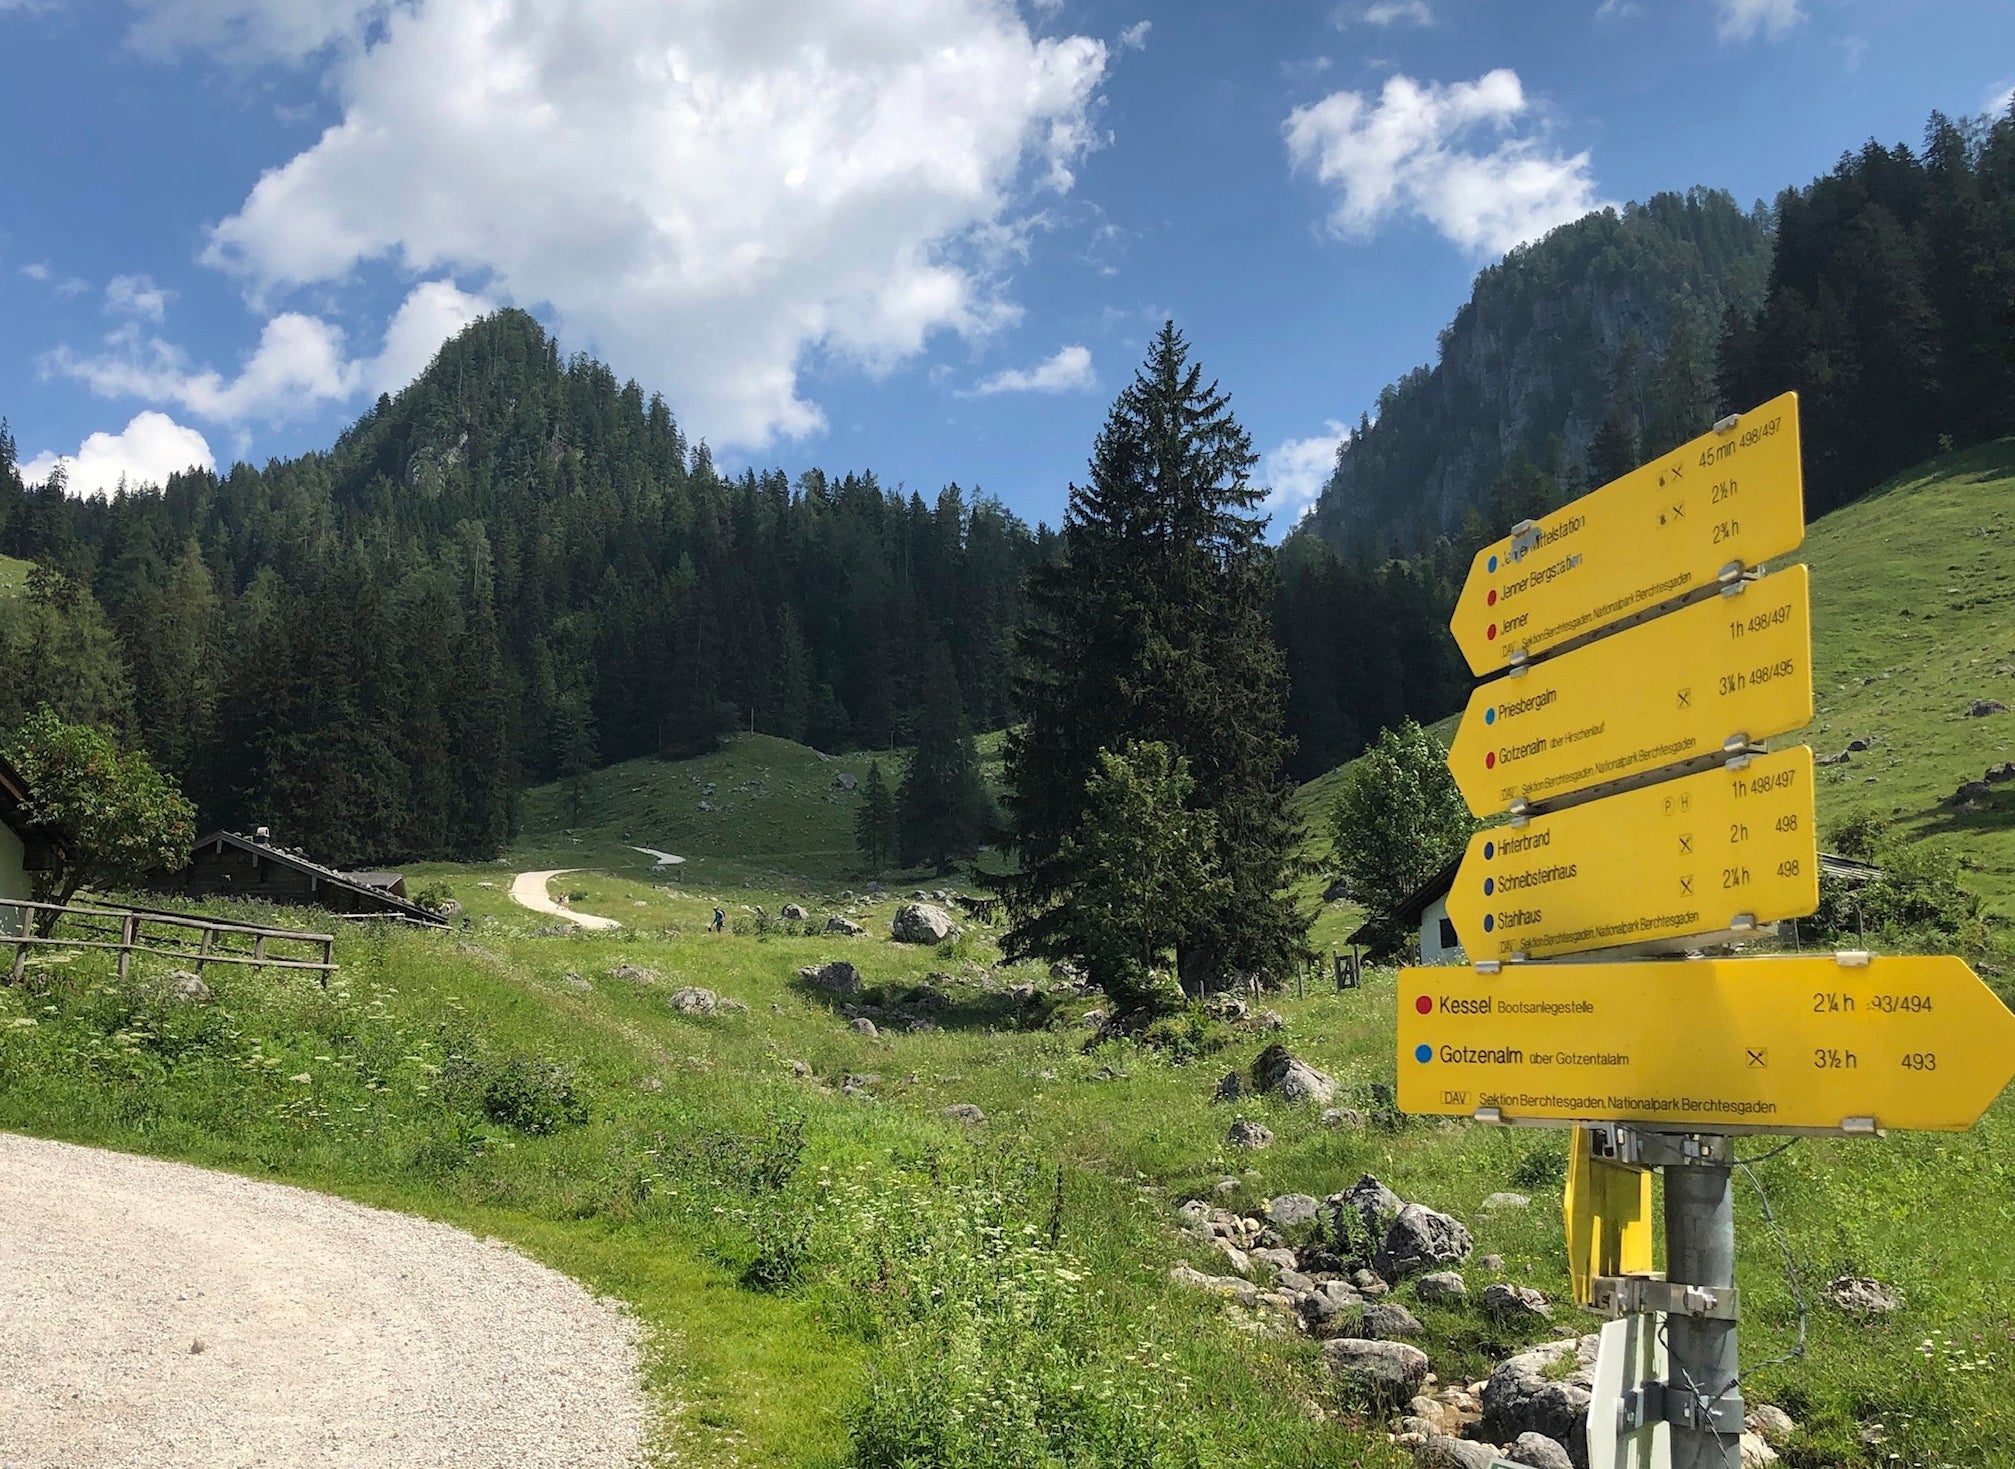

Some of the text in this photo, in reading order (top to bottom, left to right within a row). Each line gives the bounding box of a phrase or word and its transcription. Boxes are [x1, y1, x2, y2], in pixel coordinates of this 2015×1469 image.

[1698, 417, 1782, 468] 45 min 498/497
[1501, 543, 1529, 567] Jeer
[1500, 577, 1529, 601] Jenner
[1635, 572, 1692, 602] Berchtesgaden
[1500, 612, 1529, 635] Jenner
[1747, 604, 1792, 632] 498/497
[1749, 659, 1793, 685] 498/495
[1498, 688, 1557, 720] Priesbergalm
[1499, 738, 1547, 764] Gotzenalm
[1638, 737, 1696, 762] Berchtesgaden
[1750, 769, 1795, 794] 498/497
[1775, 814, 1797, 832] 498
[1497, 828, 1551, 856] Hinterbrand
[1498, 864, 1577, 893] Schneibsteinhaus
[1776, 859, 1800, 877] 498
[1498, 909, 1542, 930] Stahlhaus
[1595, 919, 1639, 937] Nationalpark
[1640, 910, 1699, 931] Berchtesgaden
[1439, 996, 1594, 1016] Kessel Bootsanlegestelle
[1813, 992, 1855, 1013] 2¼ h
[1866, 995, 1933, 1013] 93/494
[1439, 1044, 1523, 1065] Gotzenalm
[1555, 1052, 1630, 1066] Gotzentalalm
[1813, 1049, 1857, 1069] 3½ h
[1901, 1053, 1936, 1071] 493
[1444, 1091, 1467, 1105] DAV
[1479, 1092, 1520, 1107] Sektion
[1607, 1095, 1679, 1113] Nationalpark
[1681, 1097, 1777, 1116] Berchtesgaden
